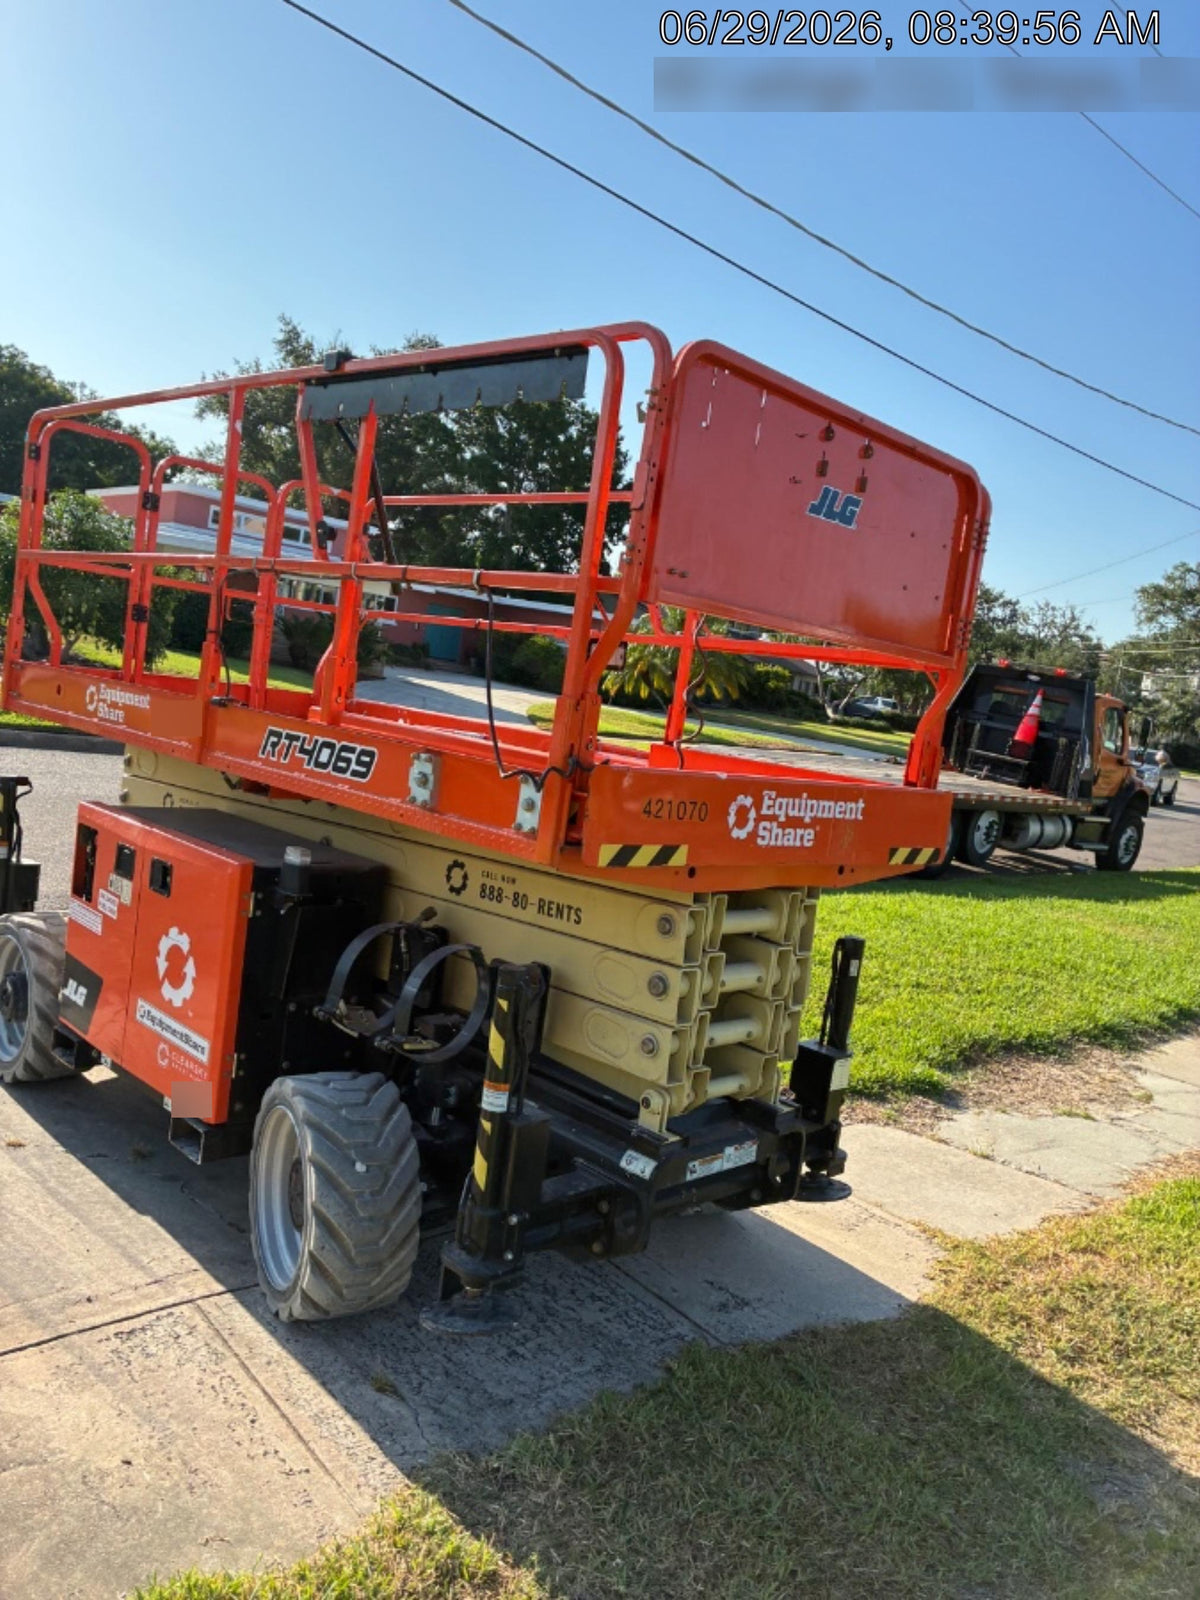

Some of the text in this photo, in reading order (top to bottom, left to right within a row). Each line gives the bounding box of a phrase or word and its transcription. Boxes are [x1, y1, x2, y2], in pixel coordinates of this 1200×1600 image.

[805, 485, 864, 531] JLG
[99, 683, 151, 710] Equipment
[97, 702, 125, 722] Share
[258, 726, 379, 783] RT4069
[642, 798, 709, 823] 421070
[760, 790, 866, 823] Equipment
[756, 821, 815, 848] Share
[481, 870, 498, 881] CALL
[479, 882, 583, 926] 888-80-RENTS
[61, 977, 88, 1007] JLG
